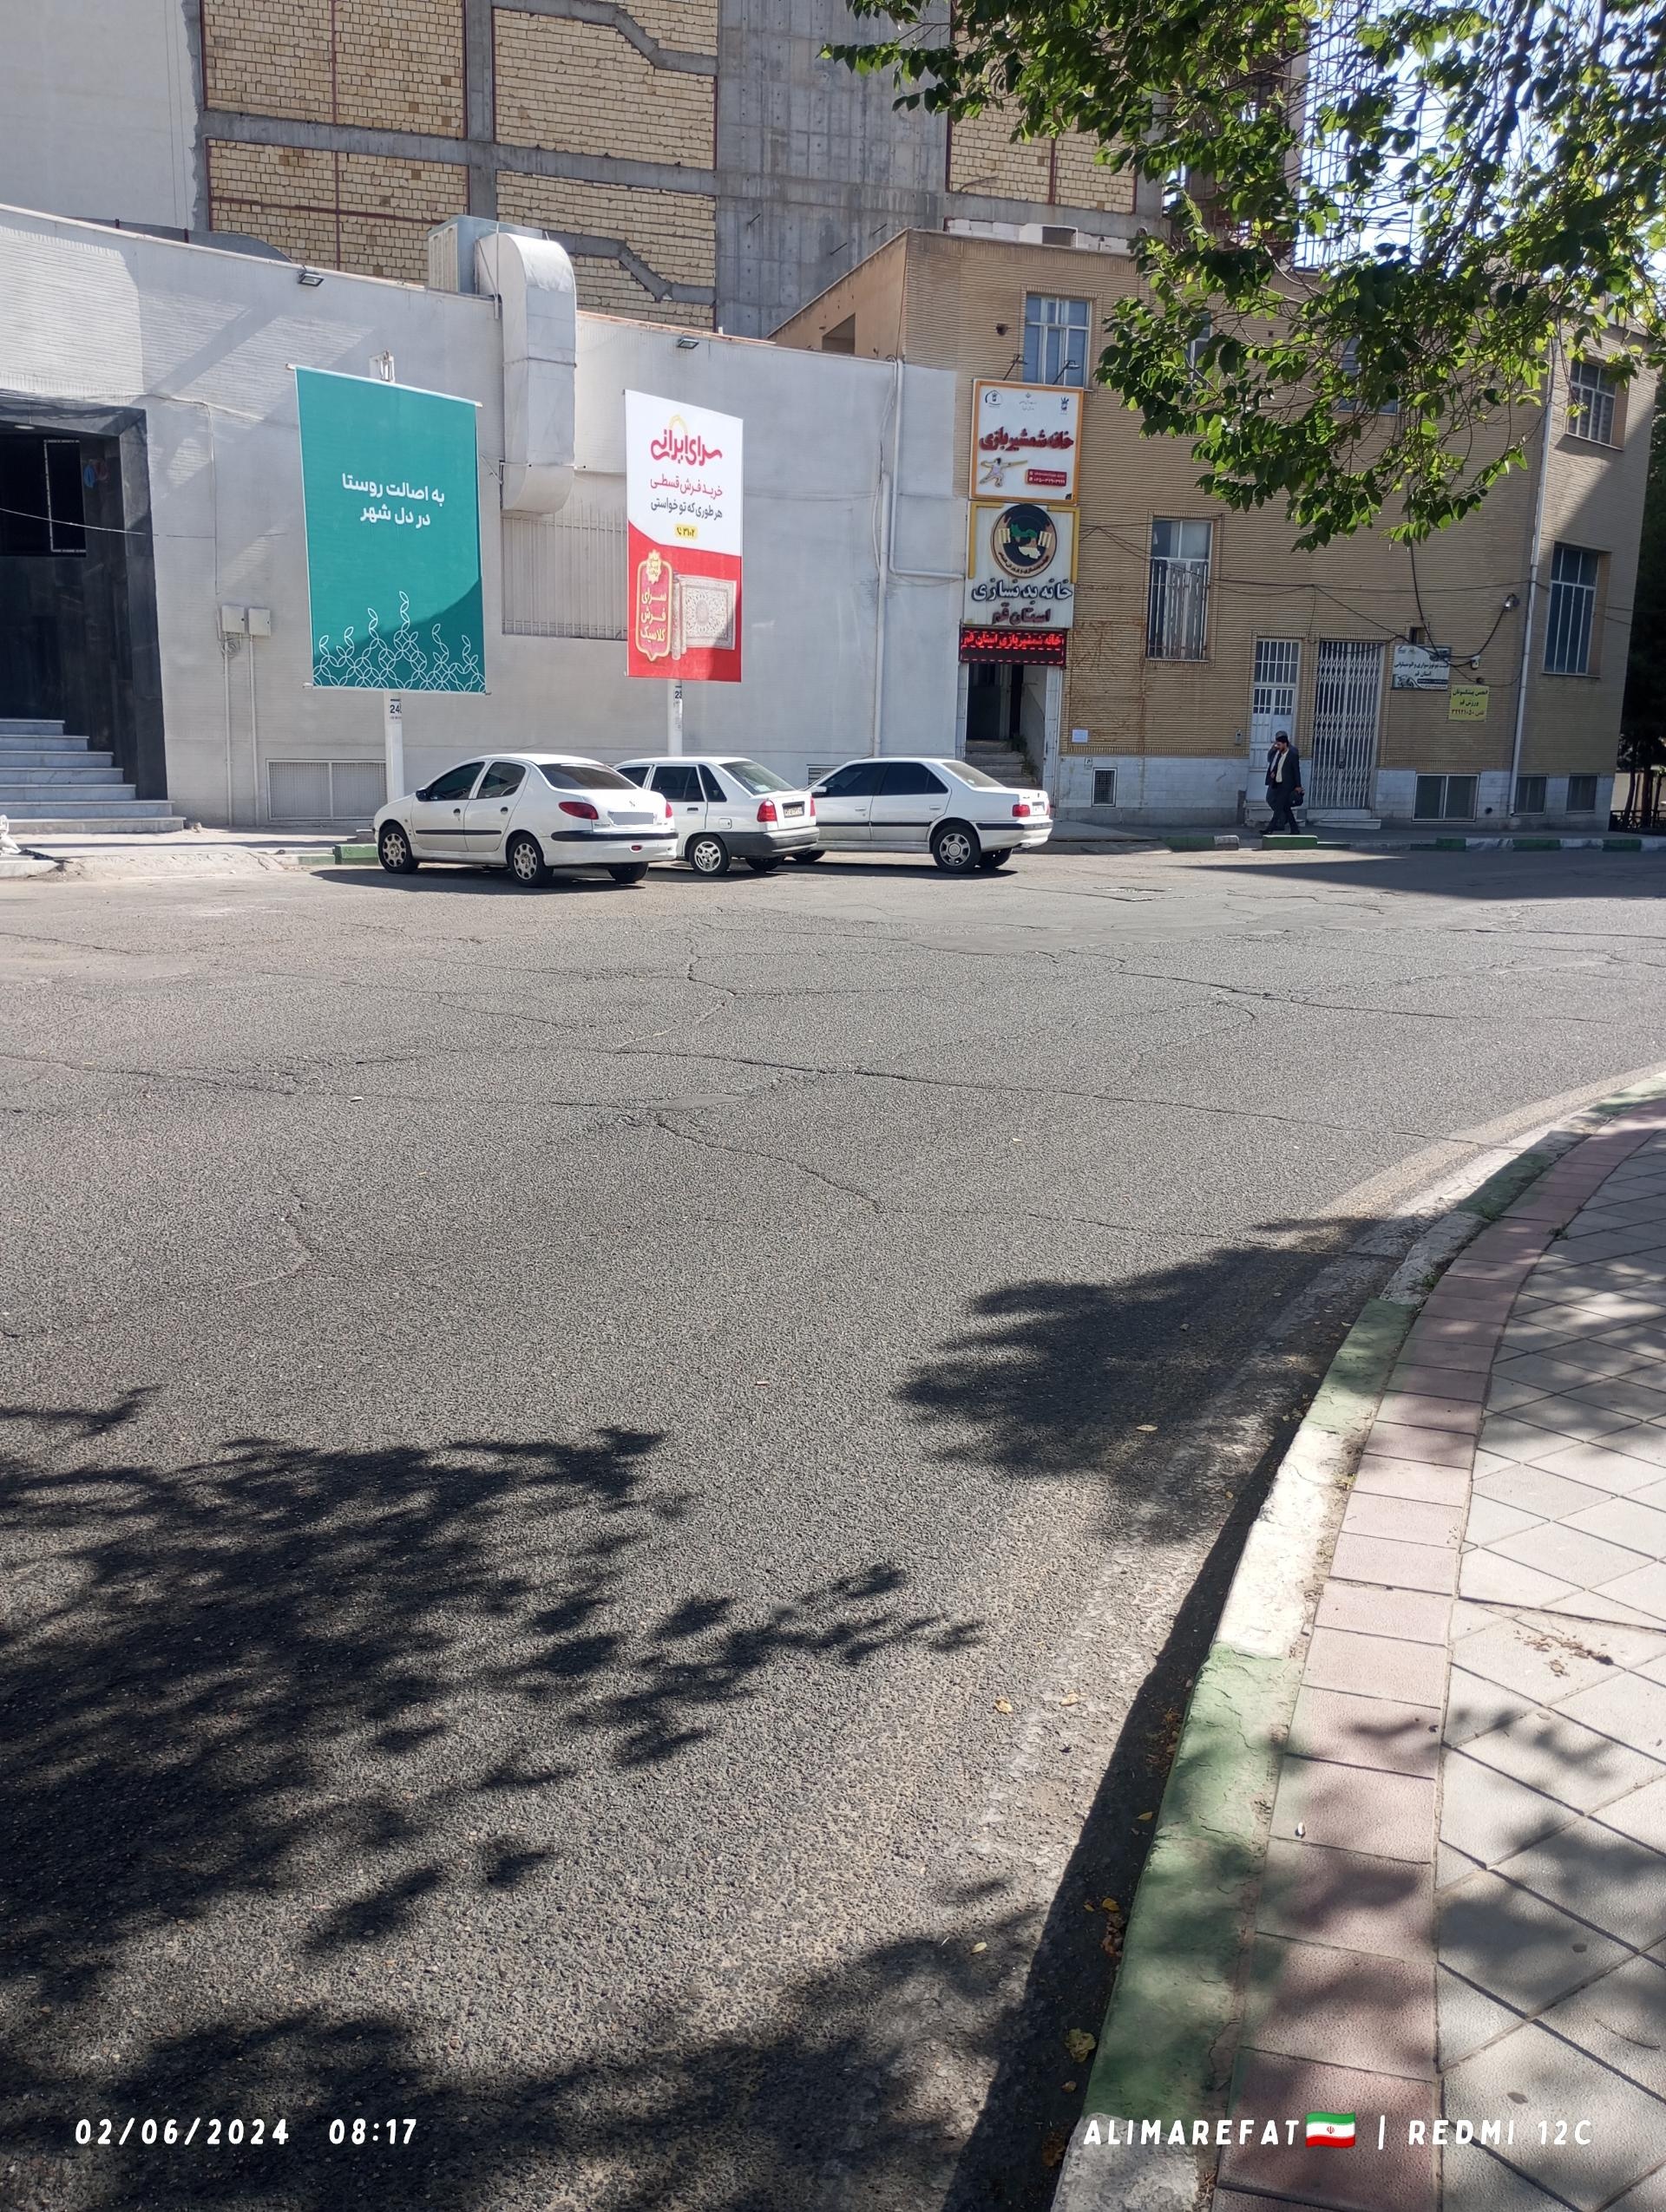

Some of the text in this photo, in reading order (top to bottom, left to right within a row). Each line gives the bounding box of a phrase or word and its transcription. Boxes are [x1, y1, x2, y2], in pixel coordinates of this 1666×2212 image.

[650, 429, 723, 467] سرای ایرانی
[1047, 430, 1074, 449] خانه
[342, 473, 445, 507] به اصالت روستا
[650, 473, 724, 501] خرید فرش قسطی
[360, 503, 431, 529] در دل شهر
[651, 497, 723, 520] هر طوری که تو خواستی
[641, 587, 666, 605] سرای
[1039, 578, 1073, 601] خانه
[641, 607, 666, 625] فرش
[992, 602, 1052, 625] استان قم
[640, 625, 666, 643] کلاسیک
[964, 632, 974, 645] قم
[975, 632, 998, 646] استان
[1045, 634, 1061, 645] خانه
